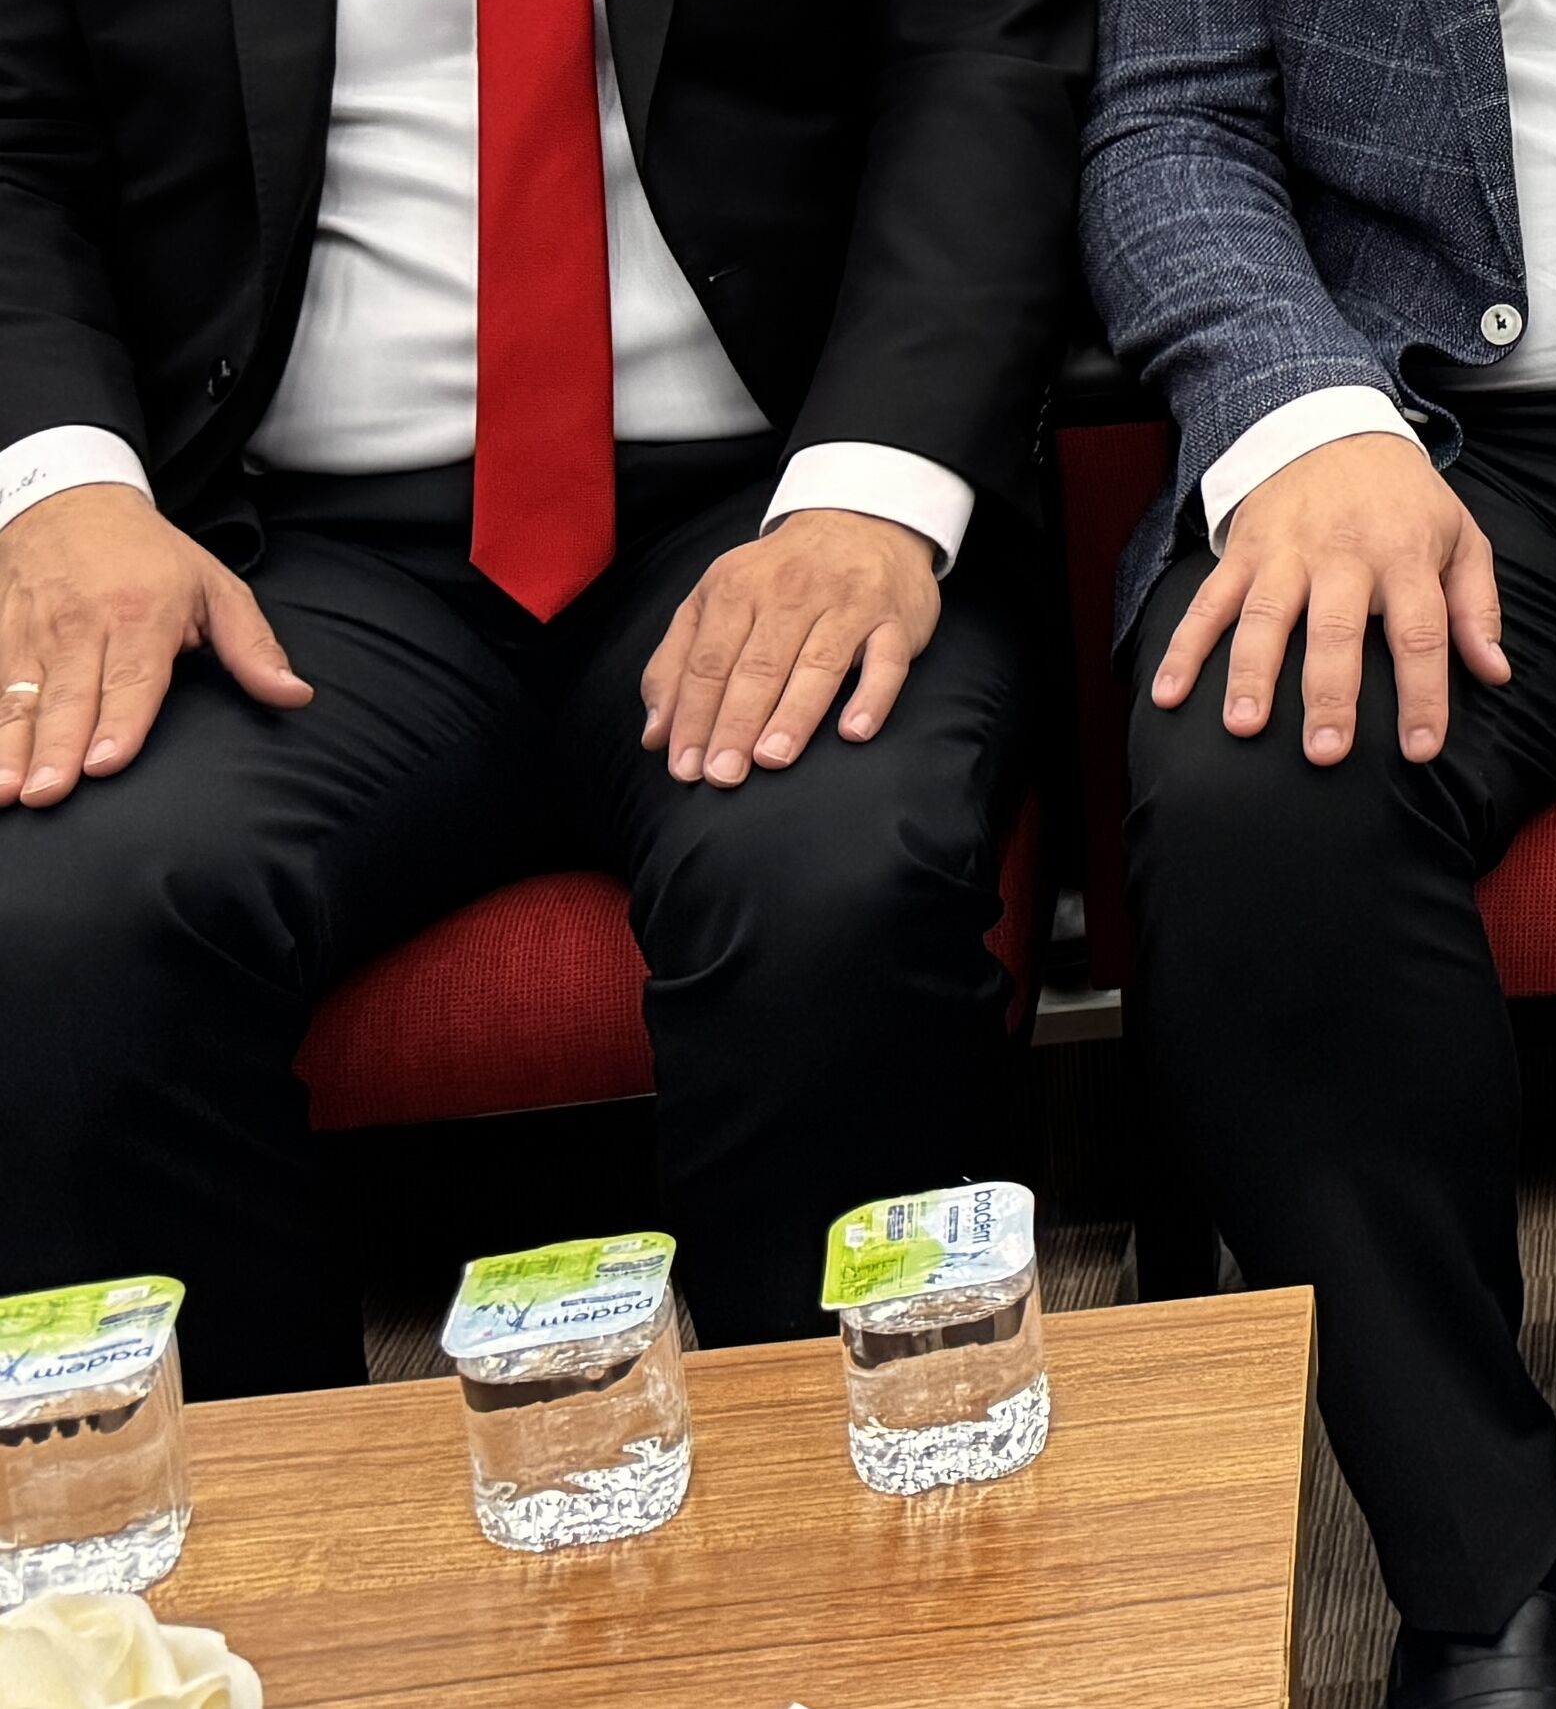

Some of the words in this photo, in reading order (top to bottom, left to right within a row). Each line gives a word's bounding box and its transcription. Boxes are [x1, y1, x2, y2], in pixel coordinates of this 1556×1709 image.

[972, 1188, 997, 1244] badem
[540, 1296, 654, 1327] badem
[33, 1345, 154, 1379] badem
